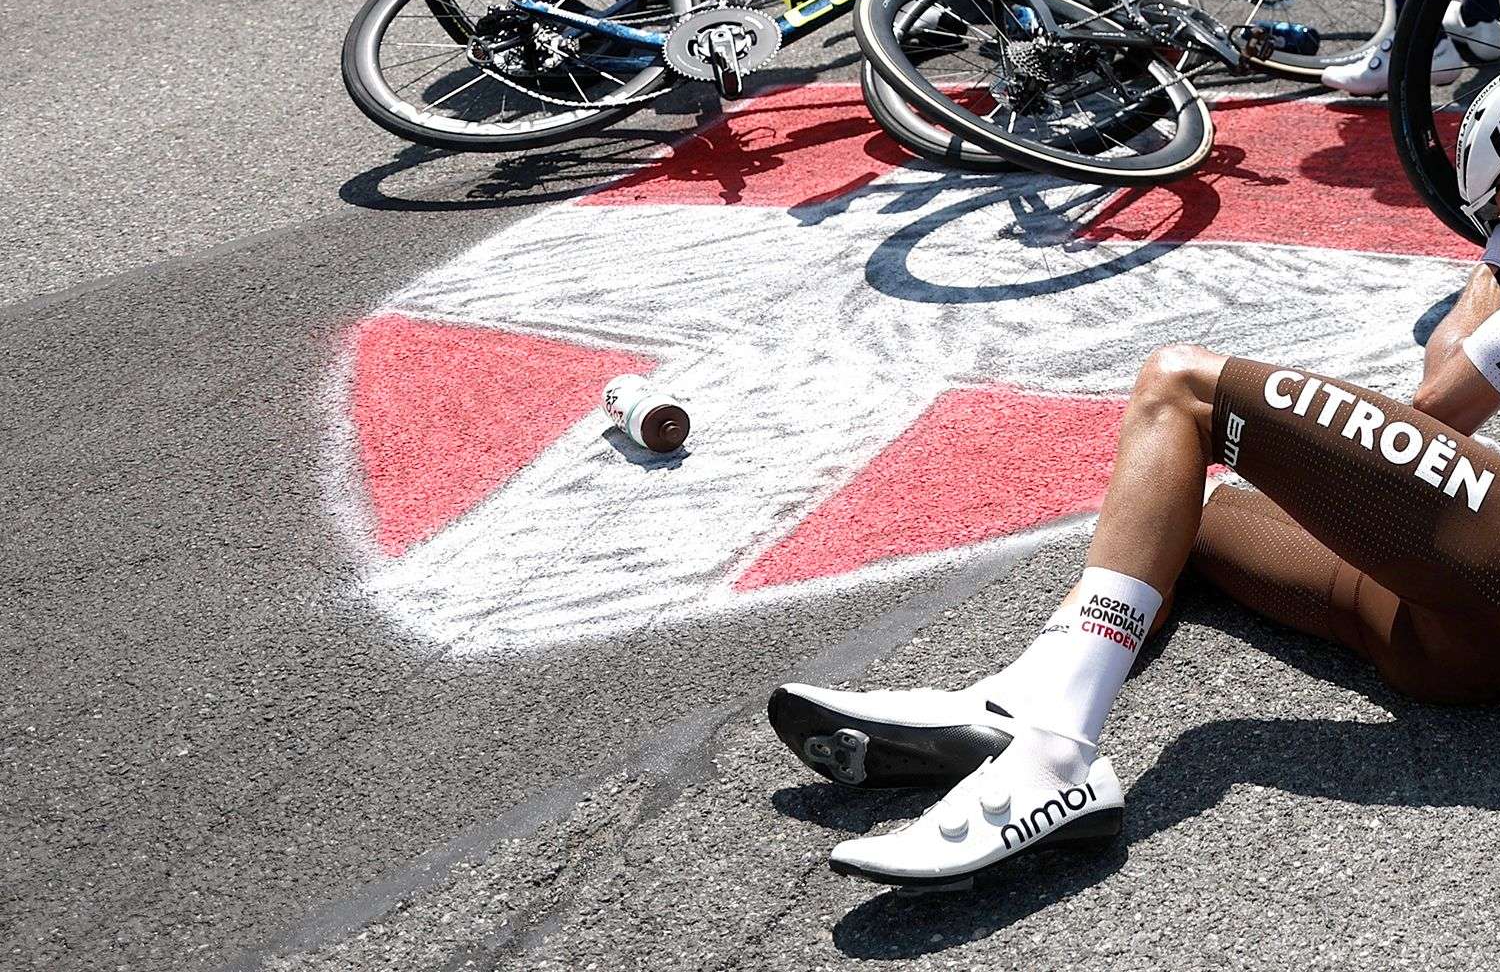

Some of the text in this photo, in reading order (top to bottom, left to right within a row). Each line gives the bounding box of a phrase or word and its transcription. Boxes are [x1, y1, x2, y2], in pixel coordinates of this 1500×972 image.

[1263, 369, 1497, 514] CITROËN
[1079, 605, 1146, 642] MONDIALE
[1089, 594, 1145, 627] AG2R LA
[1081, 620, 1138, 653] CITROËN
